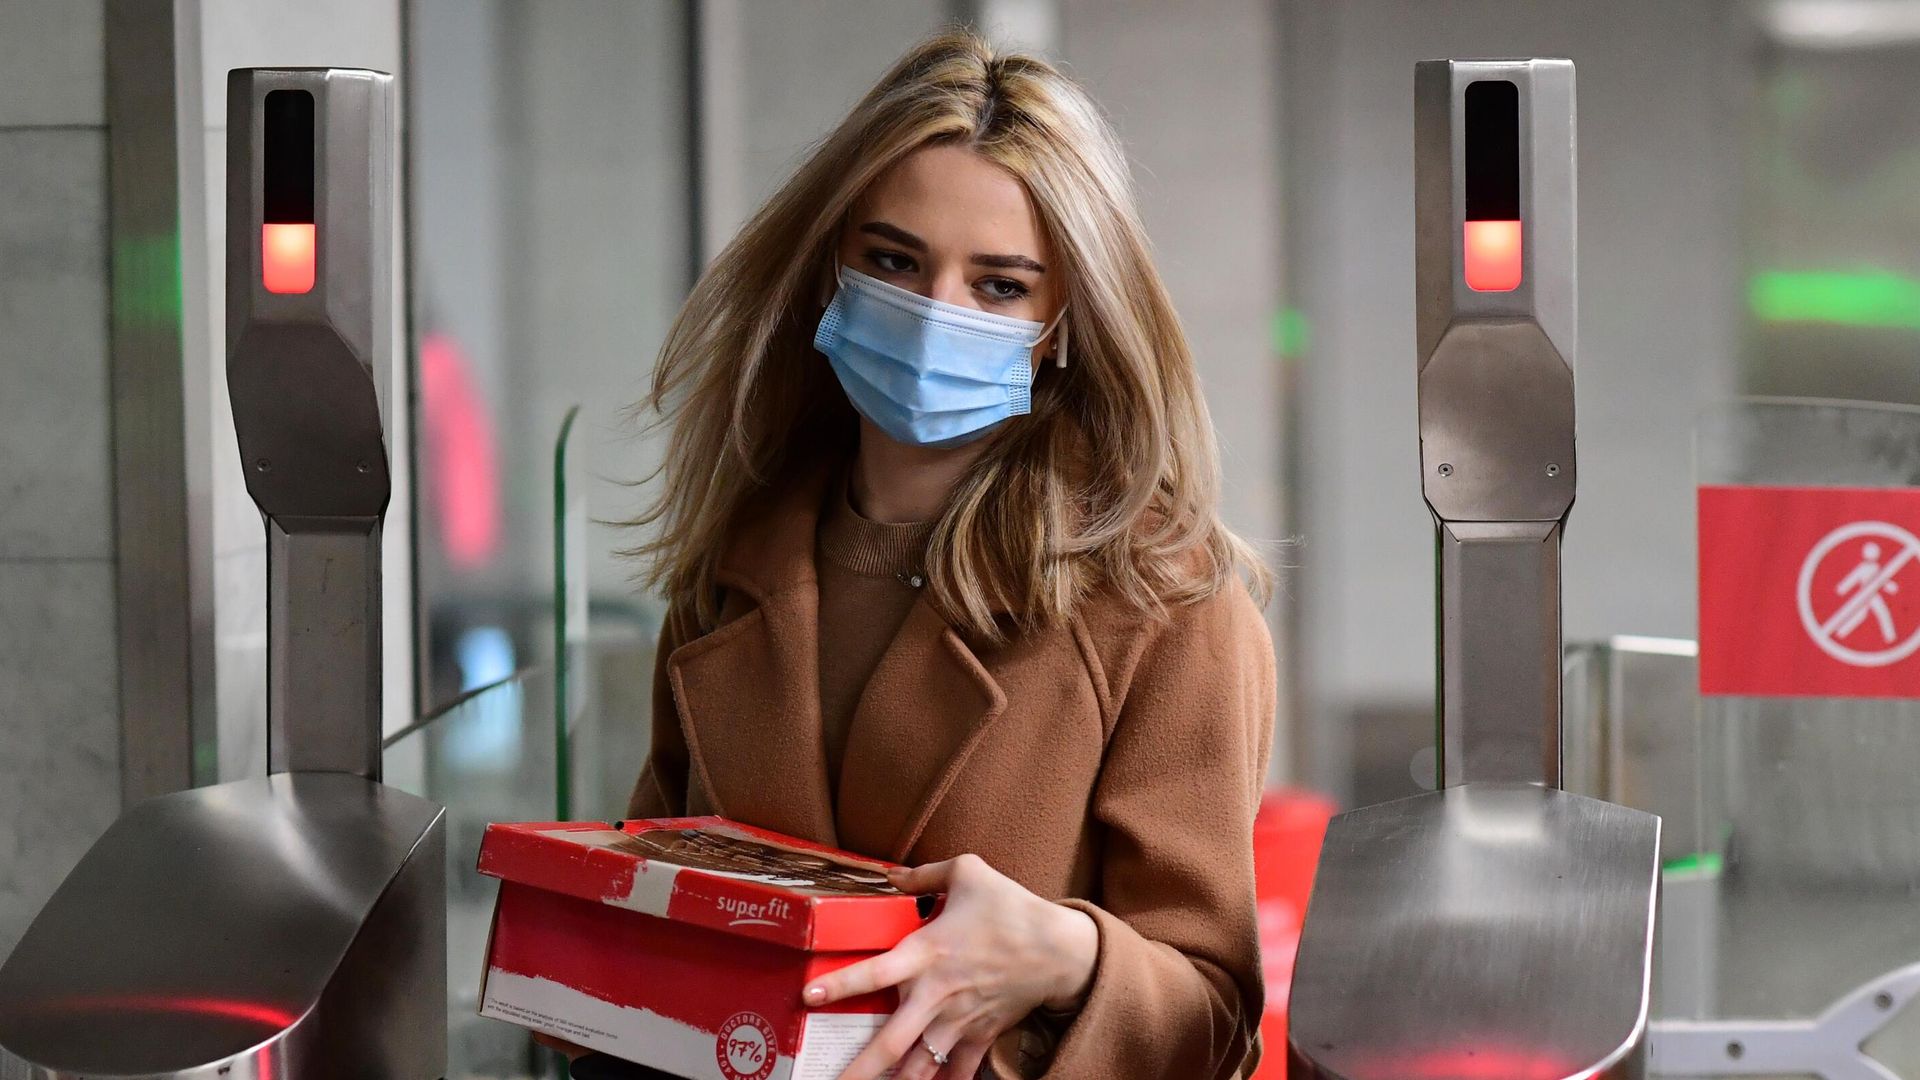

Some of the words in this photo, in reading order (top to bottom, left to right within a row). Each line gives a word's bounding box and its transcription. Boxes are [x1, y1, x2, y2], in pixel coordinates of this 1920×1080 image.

[716, 896, 790, 919] superfit
[720, 1014, 761, 1040] DOCTORS
[762, 1026, 776, 1052] GIVE
[729, 1038, 762, 1063] 97%
